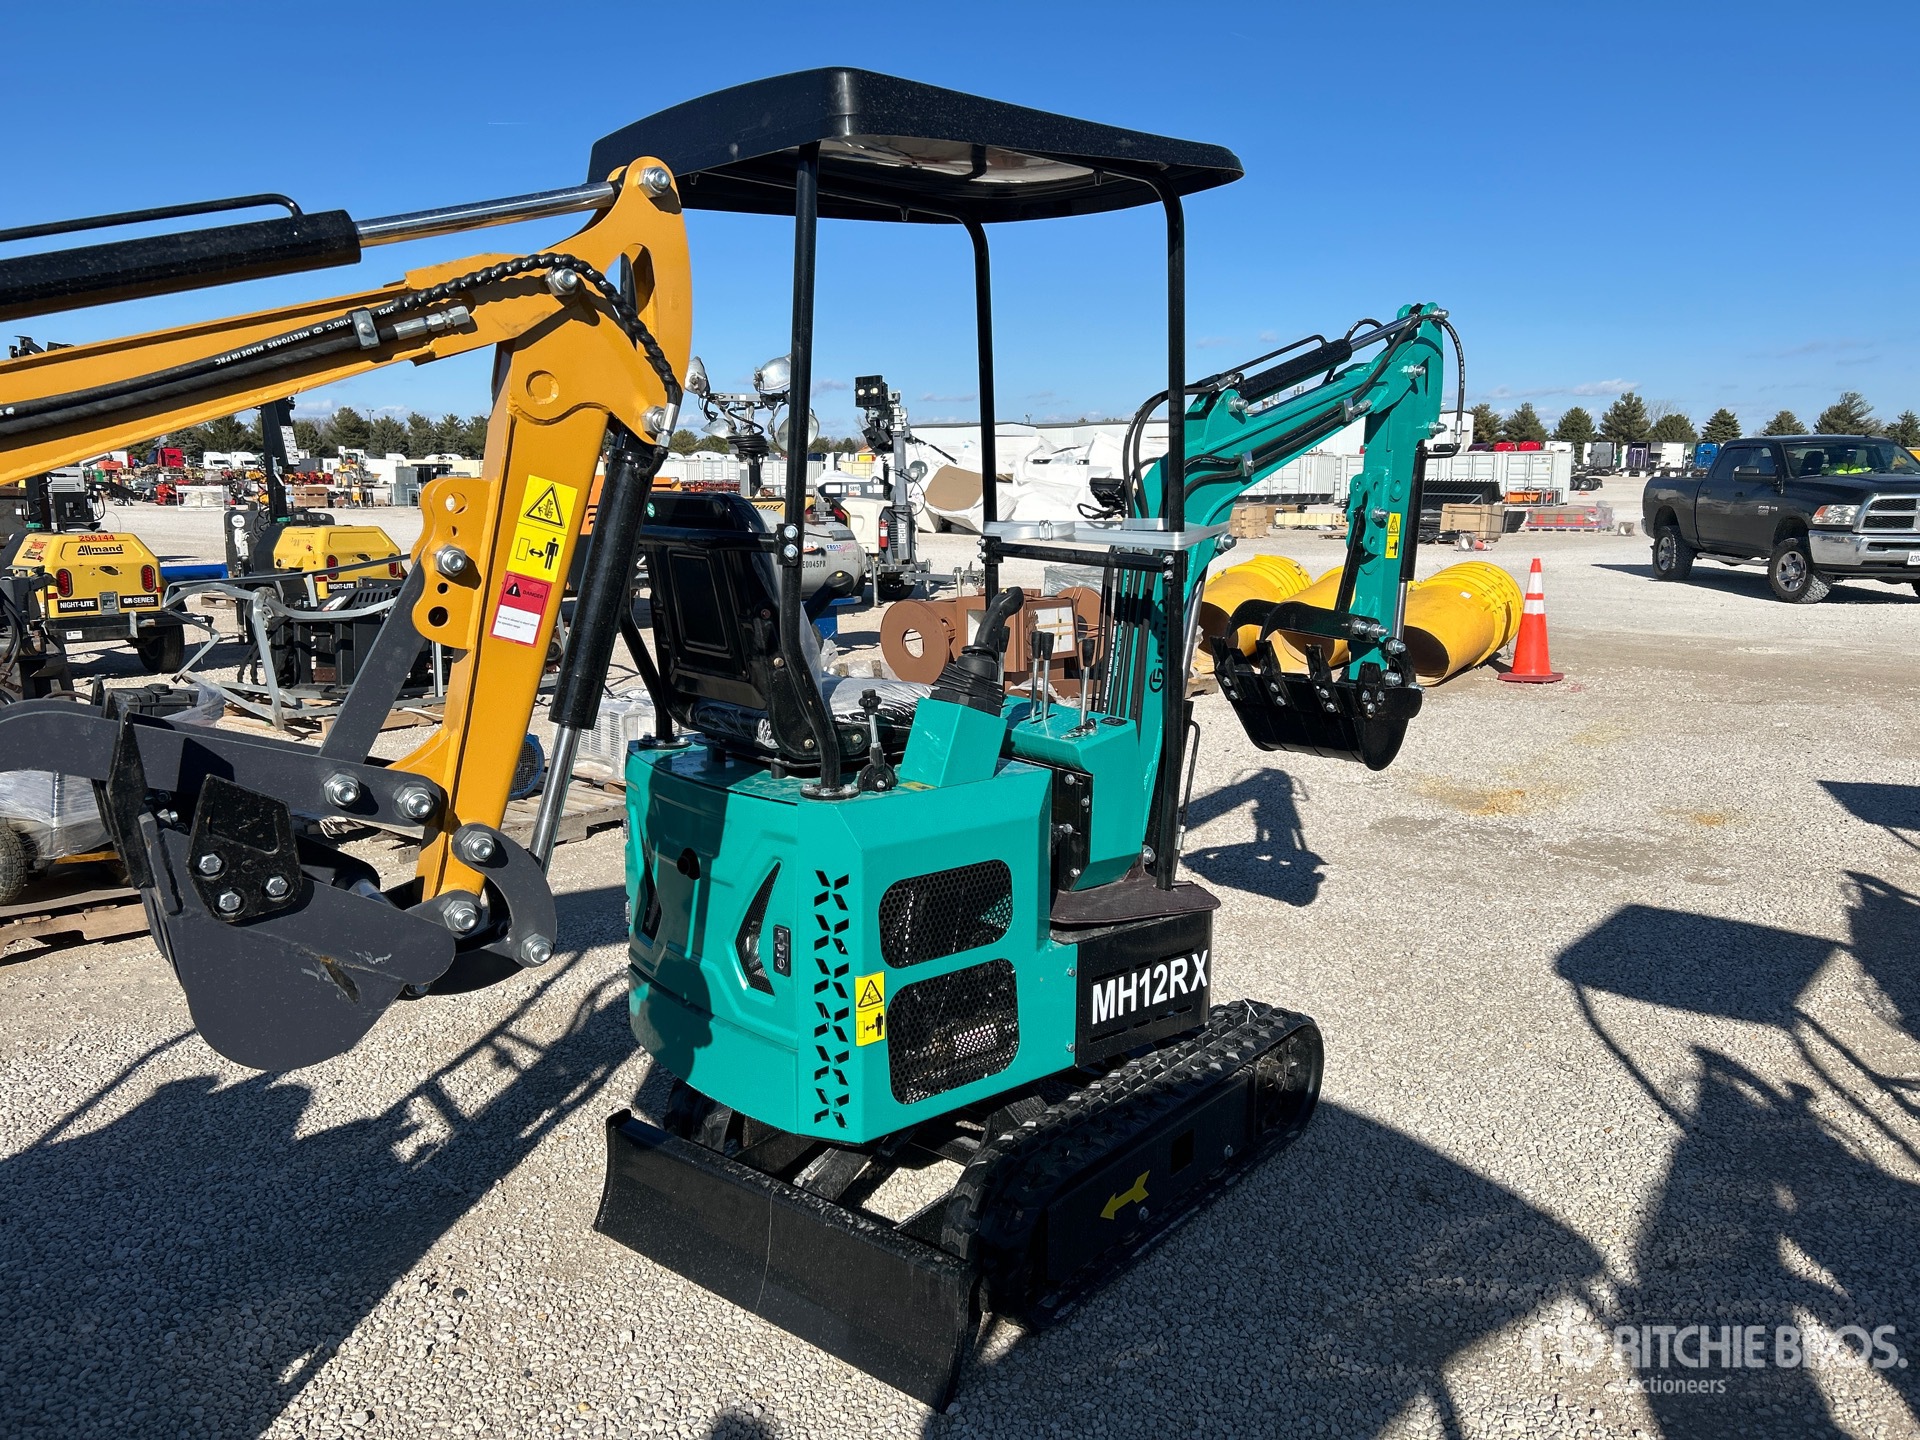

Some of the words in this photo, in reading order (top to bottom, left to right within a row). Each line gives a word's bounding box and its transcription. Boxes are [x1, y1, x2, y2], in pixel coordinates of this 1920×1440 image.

[231, 353, 241, 361] IN
[240, 345, 264, 359] MADE
[214, 356, 231, 366] PRC
[79, 534, 115, 542] 256144
[77, 544, 123, 556] Allmand
[60, 601, 96, 609] NIGHT-LITE
[1091, 950, 1209, 1025] MH12RX
